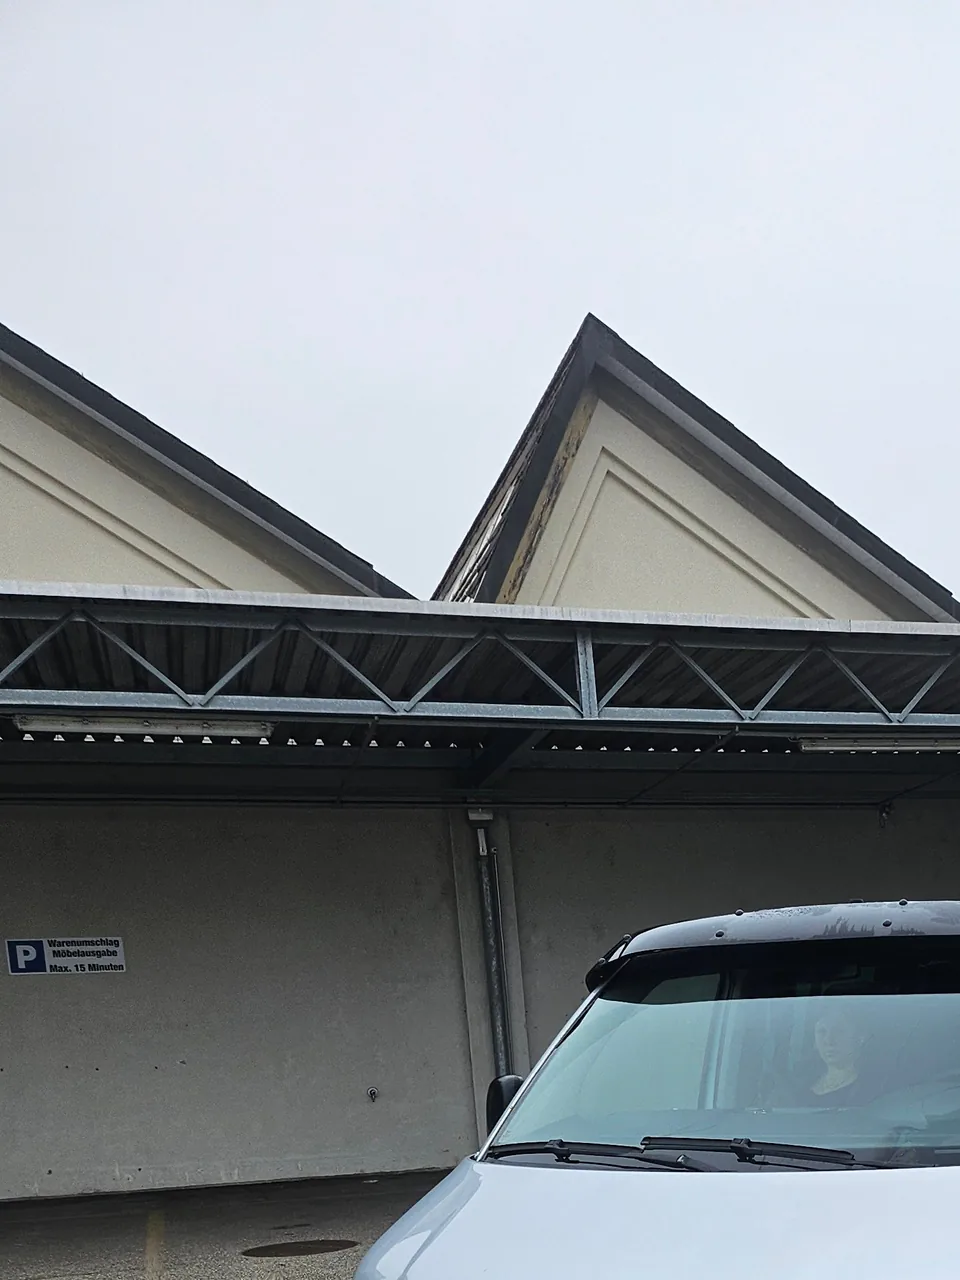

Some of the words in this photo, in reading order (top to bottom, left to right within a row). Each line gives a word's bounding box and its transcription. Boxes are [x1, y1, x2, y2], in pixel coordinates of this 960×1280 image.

[47, 938, 120, 948] Warenumschlag
[16, 945, 37, 969] P
[52, 949, 118, 958] Möbelausgabe
[49, 964, 72, 973] Max.
[74, 964, 86, 972] 15
[88, 963, 124, 972] Minuten
